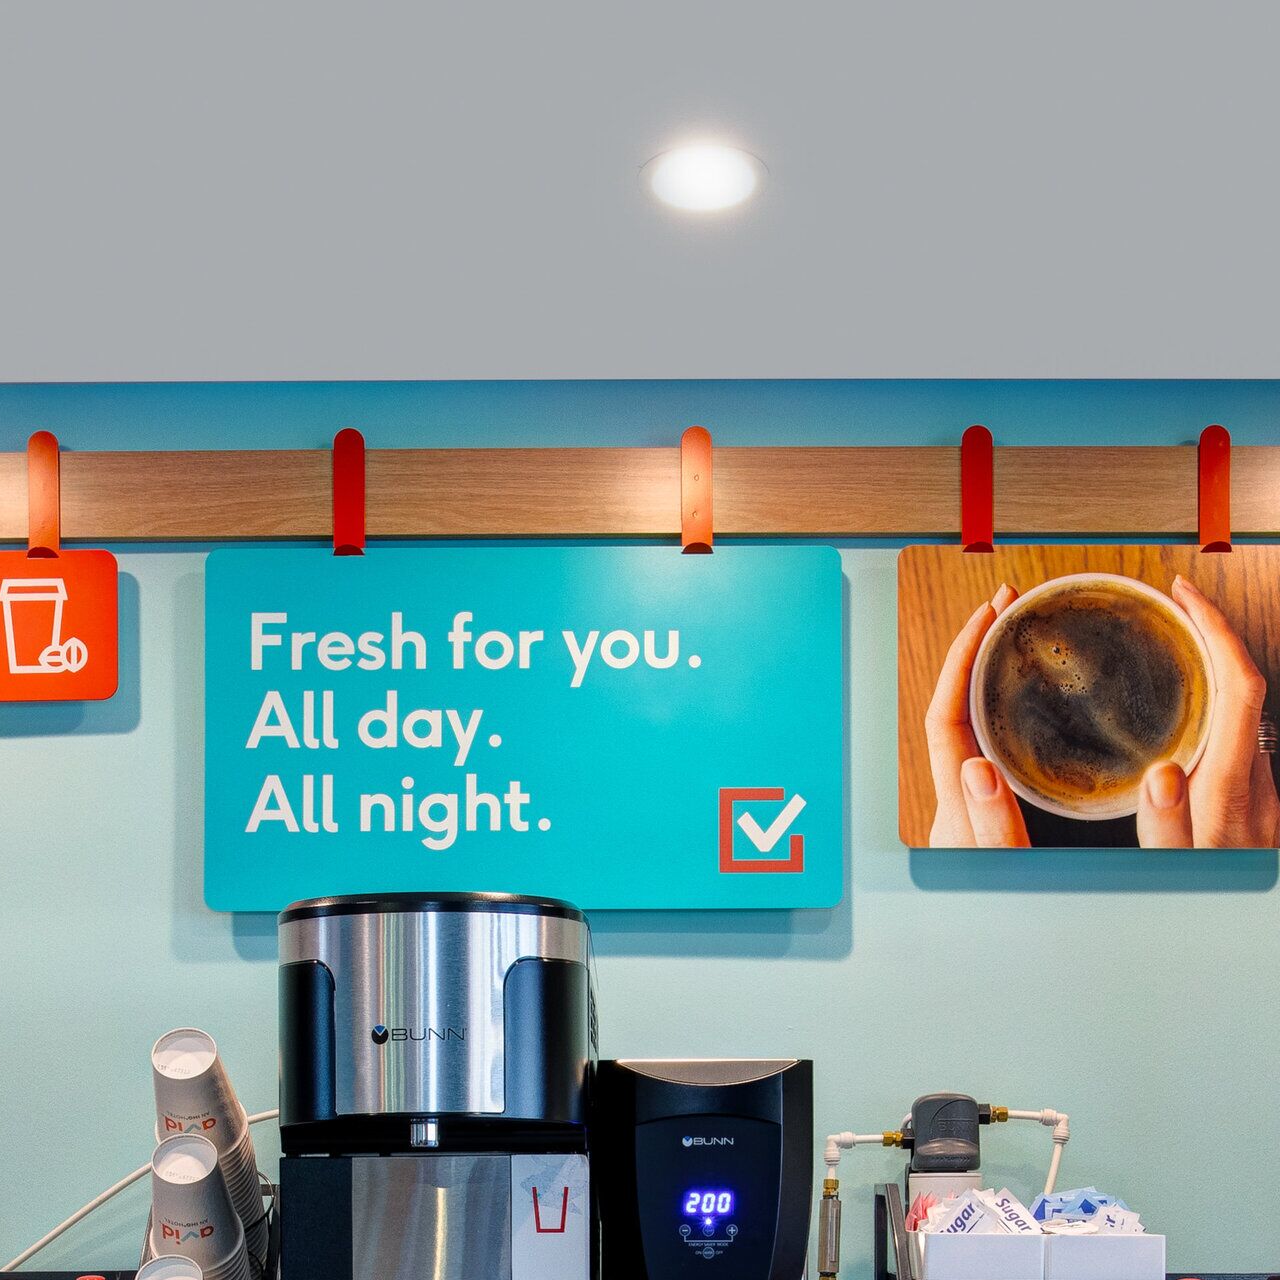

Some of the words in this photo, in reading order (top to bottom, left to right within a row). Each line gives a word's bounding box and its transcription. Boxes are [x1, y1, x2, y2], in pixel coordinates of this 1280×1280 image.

[250, 611, 427, 671] Fresh
[448, 611, 544, 670] for
[562, 629, 702, 688] you.
[245, 690, 339, 749] All
[358, 690, 502, 766] day.
[245, 774, 339, 833] All
[360, 773, 552, 851] night.
[391, 1027, 466, 1041] BUNN
[693, 1137, 735, 1146] BUNN
[685, 1192, 732, 1214] 200
[941, 1202, 976, 1233] ugar
[995, 1198, 1033, 1231] Sugar
